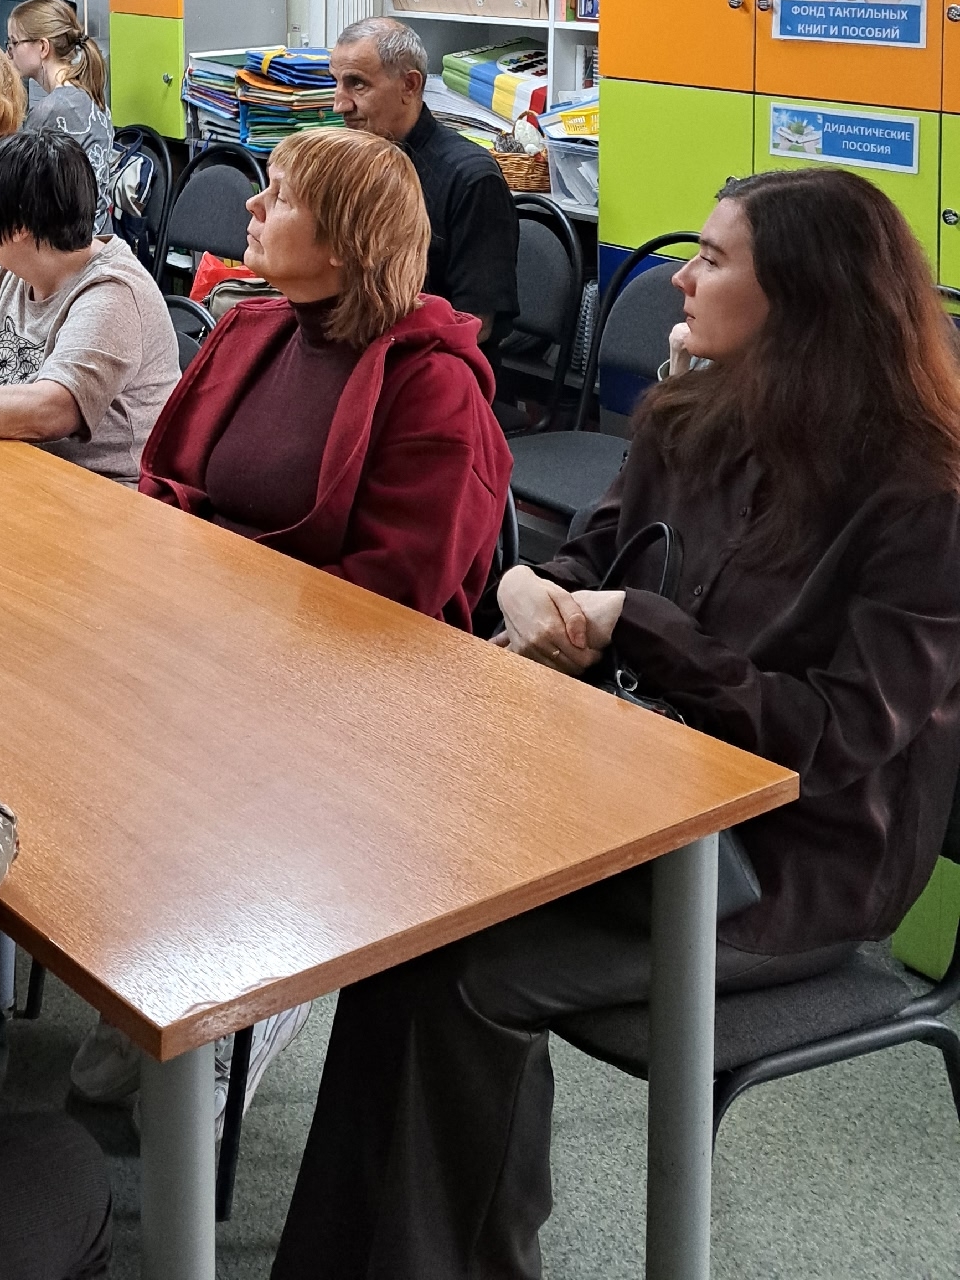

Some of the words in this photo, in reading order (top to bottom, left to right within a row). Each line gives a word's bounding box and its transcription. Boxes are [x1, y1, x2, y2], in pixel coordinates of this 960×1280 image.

[791, 5, 825, 19] ФОНД
[828, 6, 908, 21] ТАКТИЛЬНЫХ
[797, 23, 827, 36] КНИГ
[830, 25, 838, 36] И
[842, 25, 900, 39] ПОСОБИЙ
[823, 122, 911, 142] ДИДАКТИЧЕСКИЕ
[842, 140, 890, 155] ПОСОБИЯ
